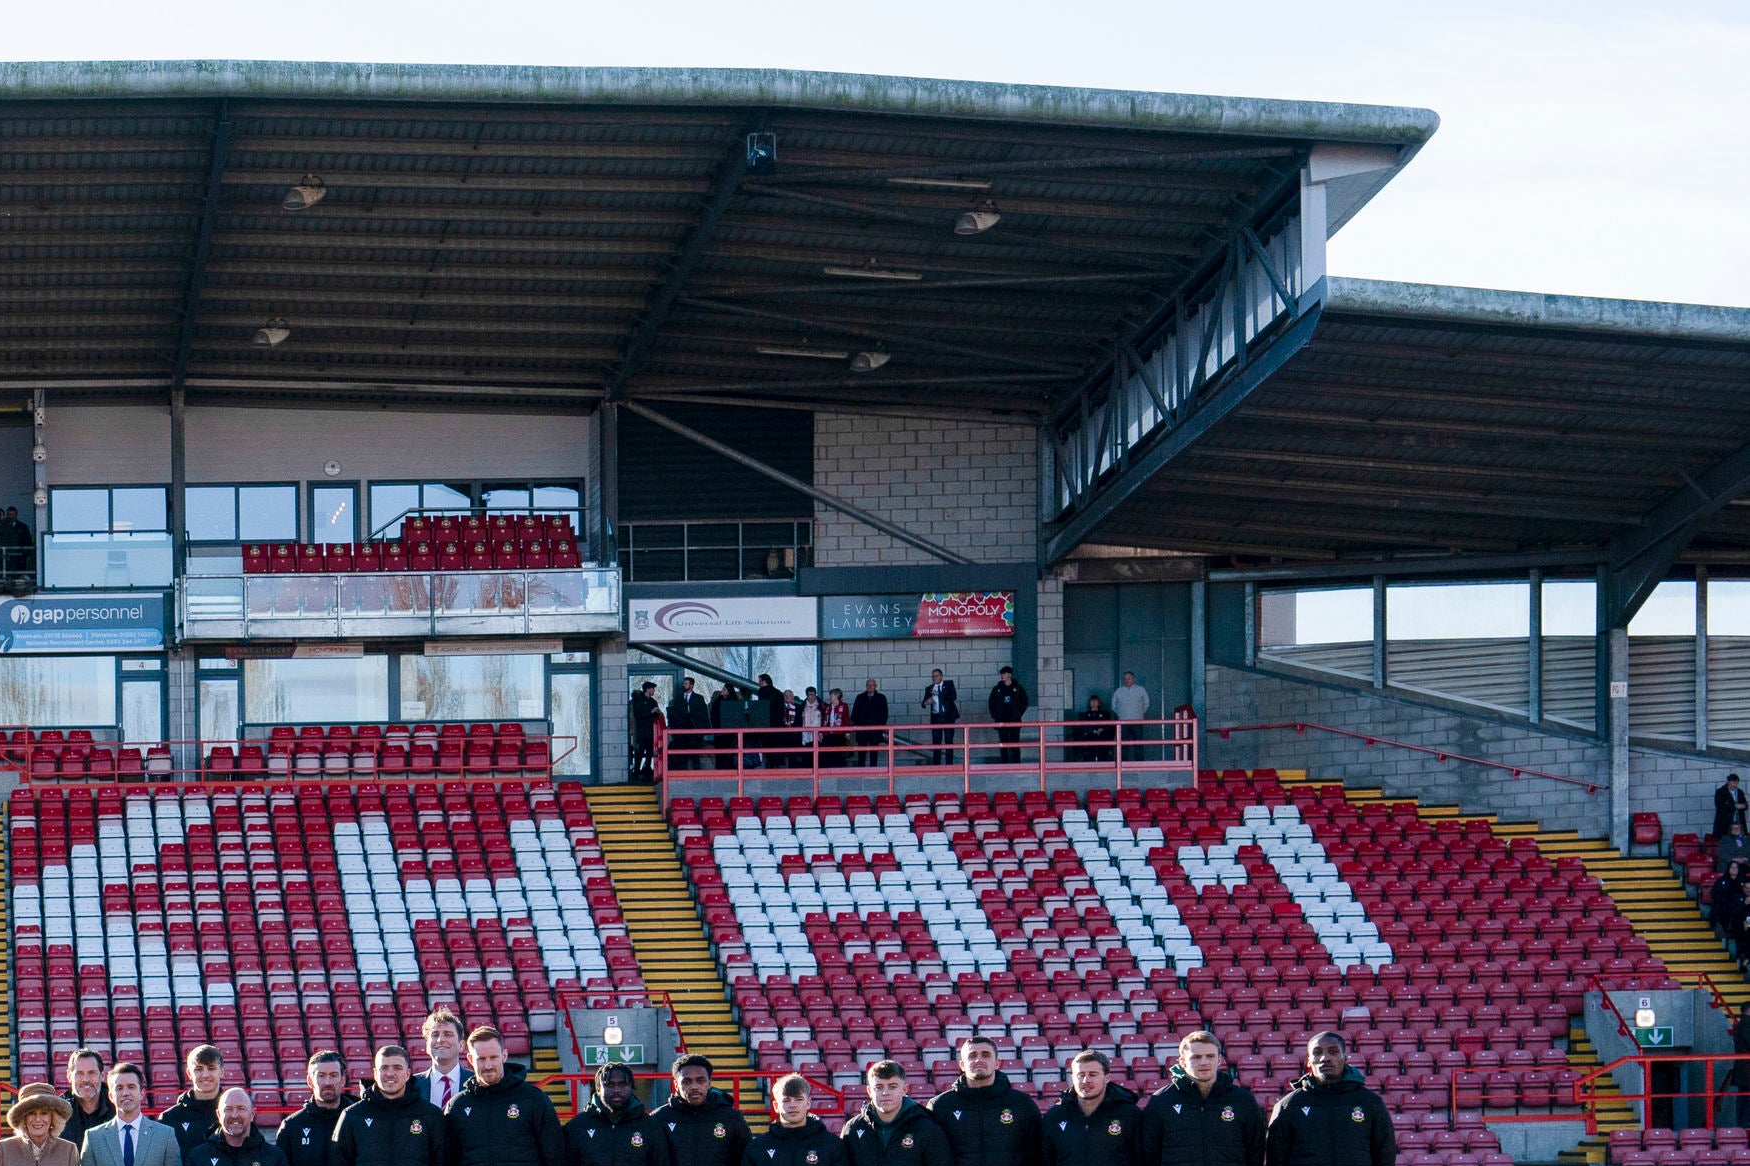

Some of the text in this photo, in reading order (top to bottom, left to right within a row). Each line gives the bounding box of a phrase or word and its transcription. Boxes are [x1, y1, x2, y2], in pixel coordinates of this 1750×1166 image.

[66, 604, 143, 623] personnel
[844, 603, 900, 615] EVANS
[928, 605, 1000, 617] MONOPOLY
[676, 619, 722, 627] Universal
[832, 617, 913, 629] LAMSLEY
[1641, 999, 1648, 1007] 6
[609, 1017, 615, 1025] 5
